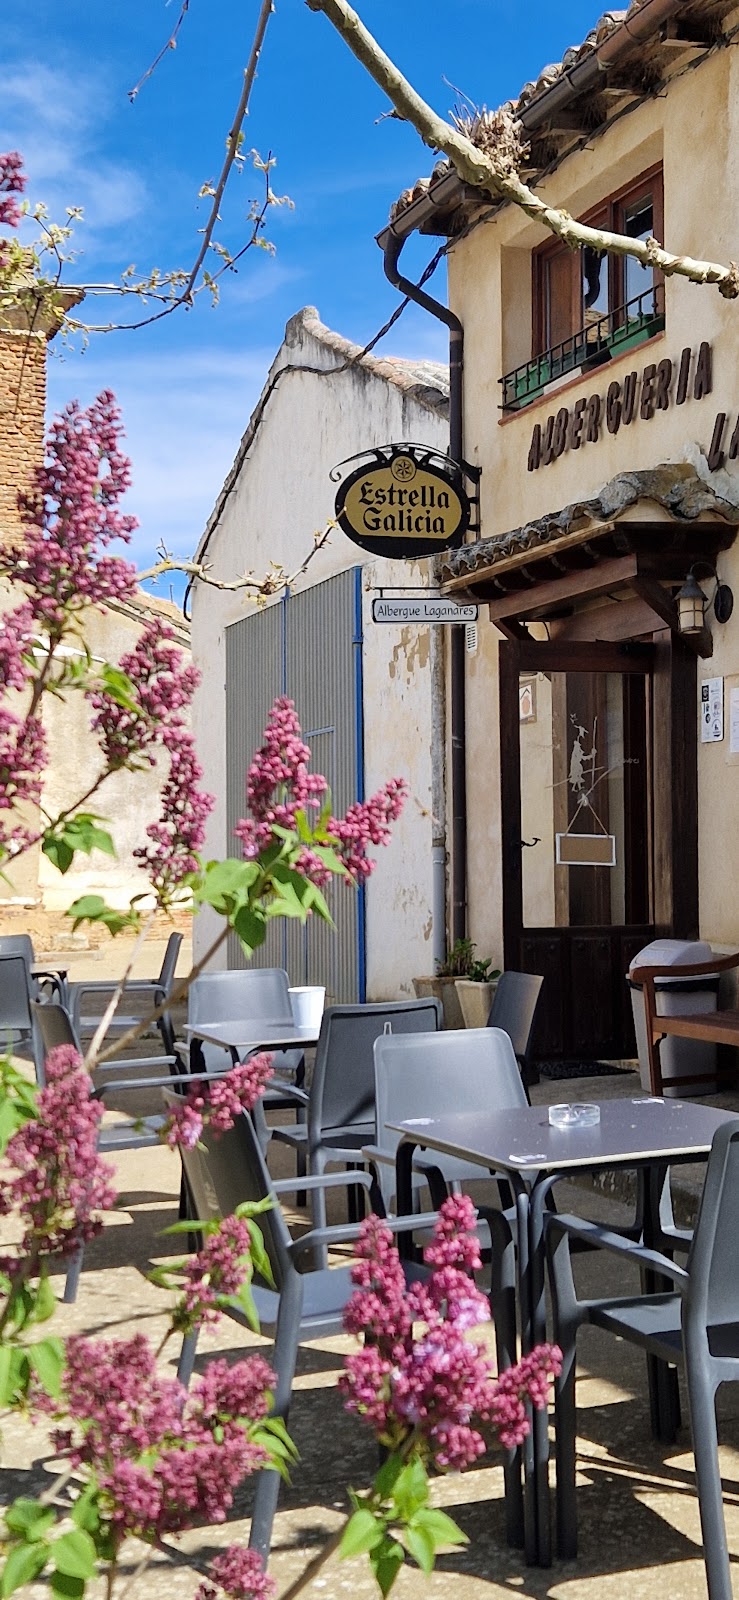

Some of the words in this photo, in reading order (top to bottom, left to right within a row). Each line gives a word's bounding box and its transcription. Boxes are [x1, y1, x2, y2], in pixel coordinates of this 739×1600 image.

[527, 341, 713, 471] ALBERGUERIA
[359, 481, 450, 509] Estrella
[363, 507, 446, 534] Galicia
[377, 604, 421, 619] Albergue
[424, 605, 474, 618] Laganares
